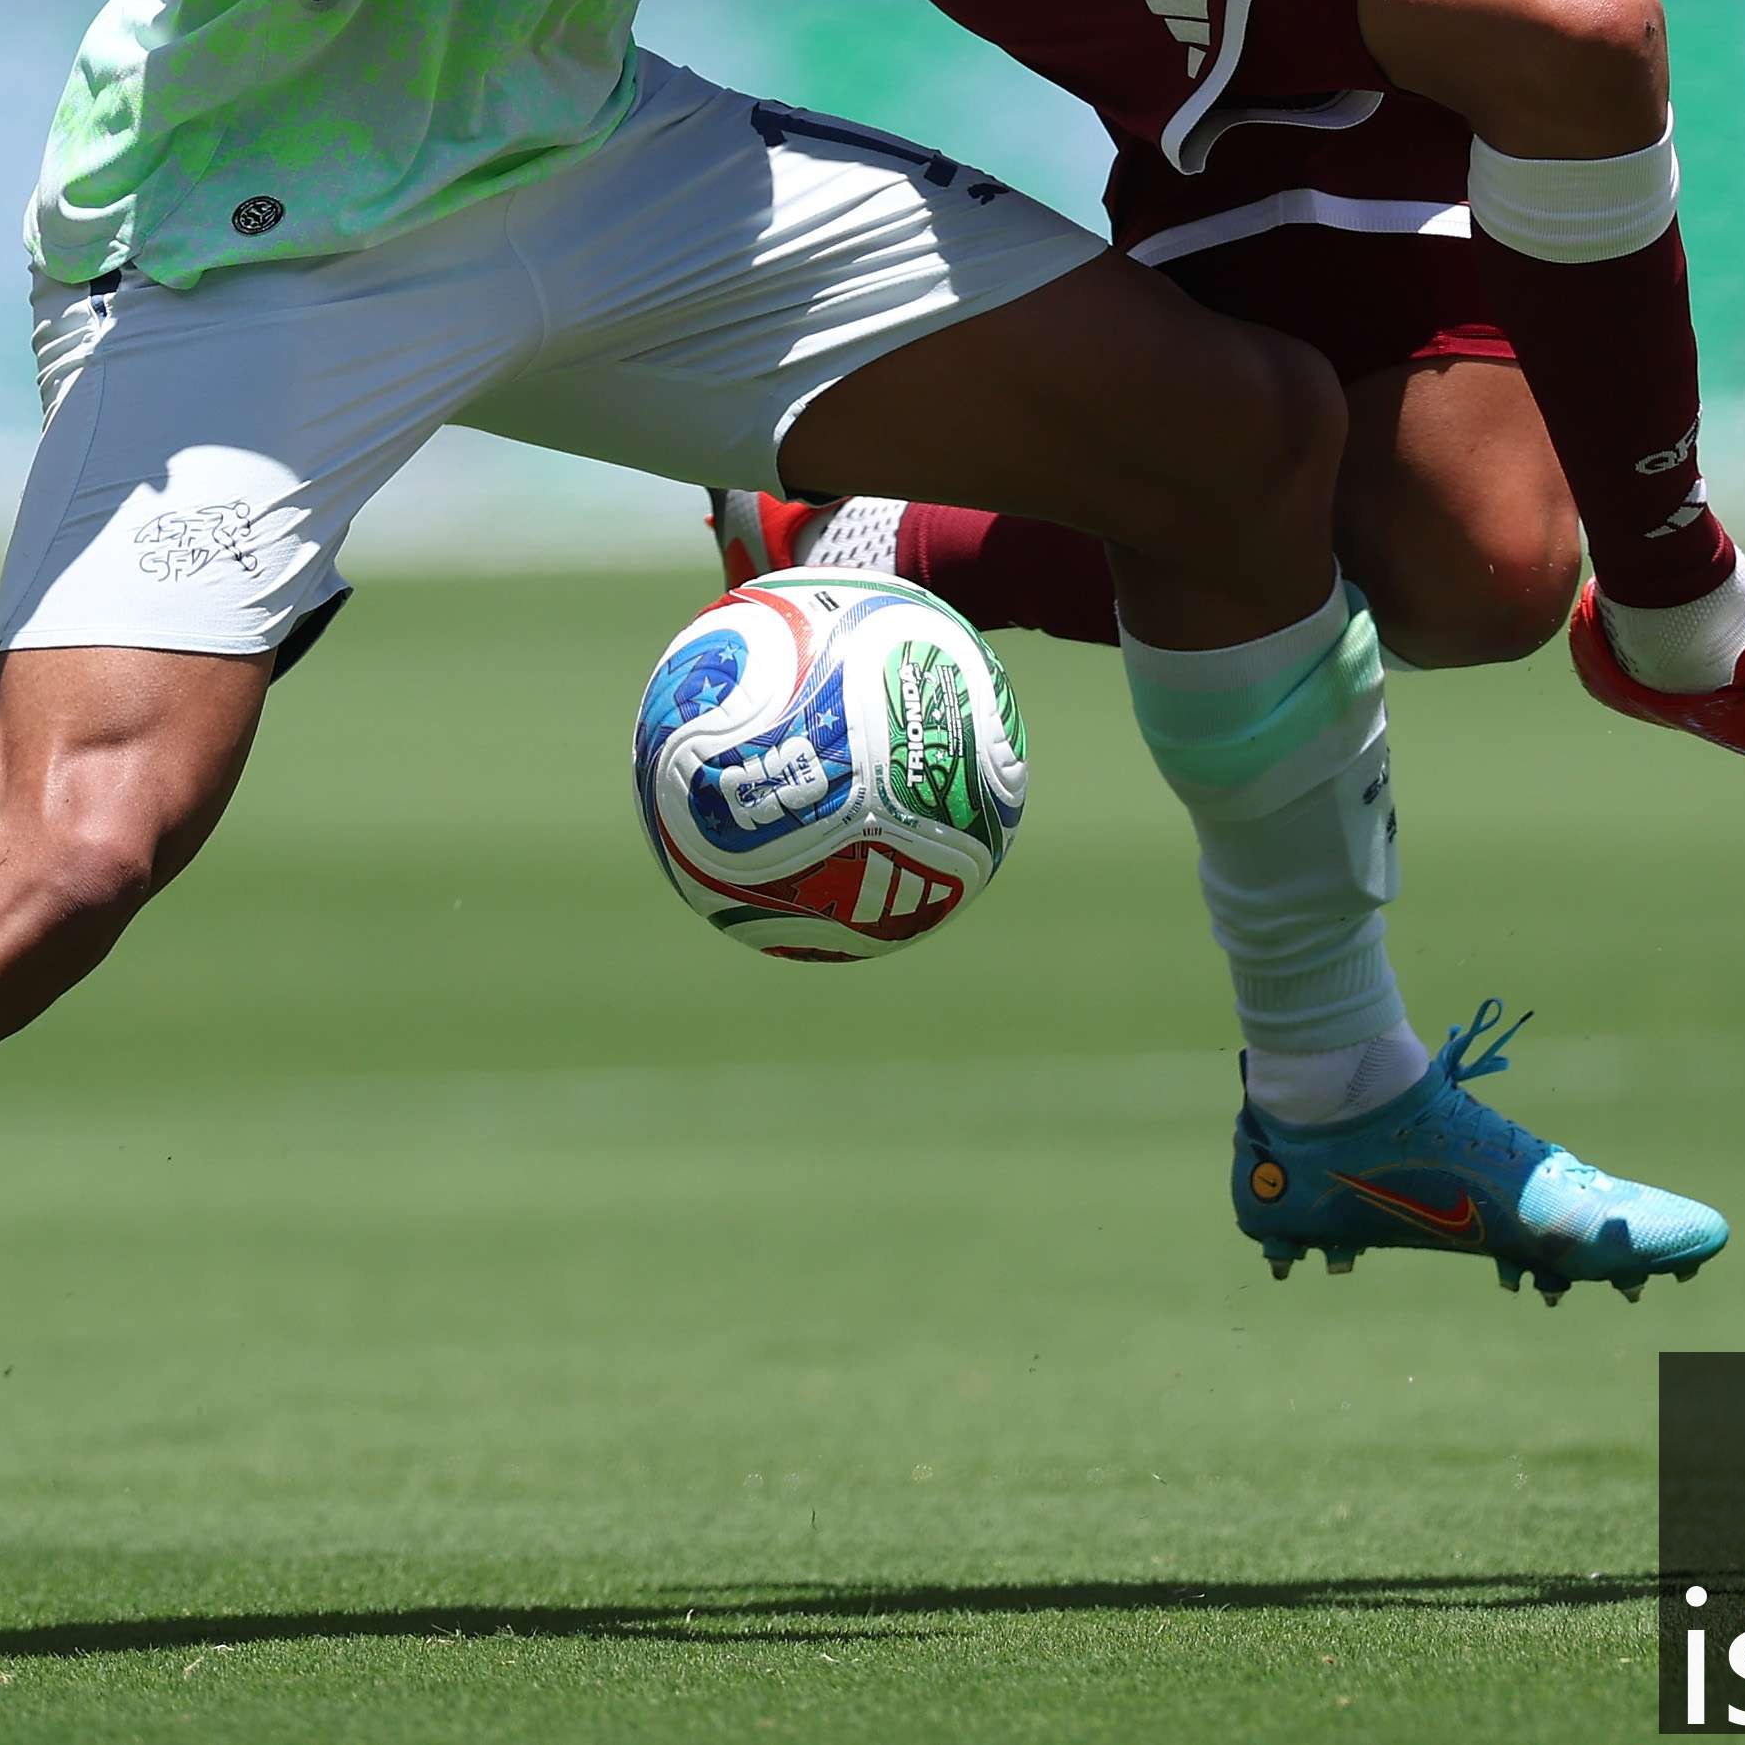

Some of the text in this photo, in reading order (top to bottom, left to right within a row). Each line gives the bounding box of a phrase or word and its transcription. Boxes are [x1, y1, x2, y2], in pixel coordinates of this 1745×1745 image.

[1635, 404, 1702, 475] QF
[899, 662, 924, 788] TRIONDA
[796, 752, 816, 784] FIFA
